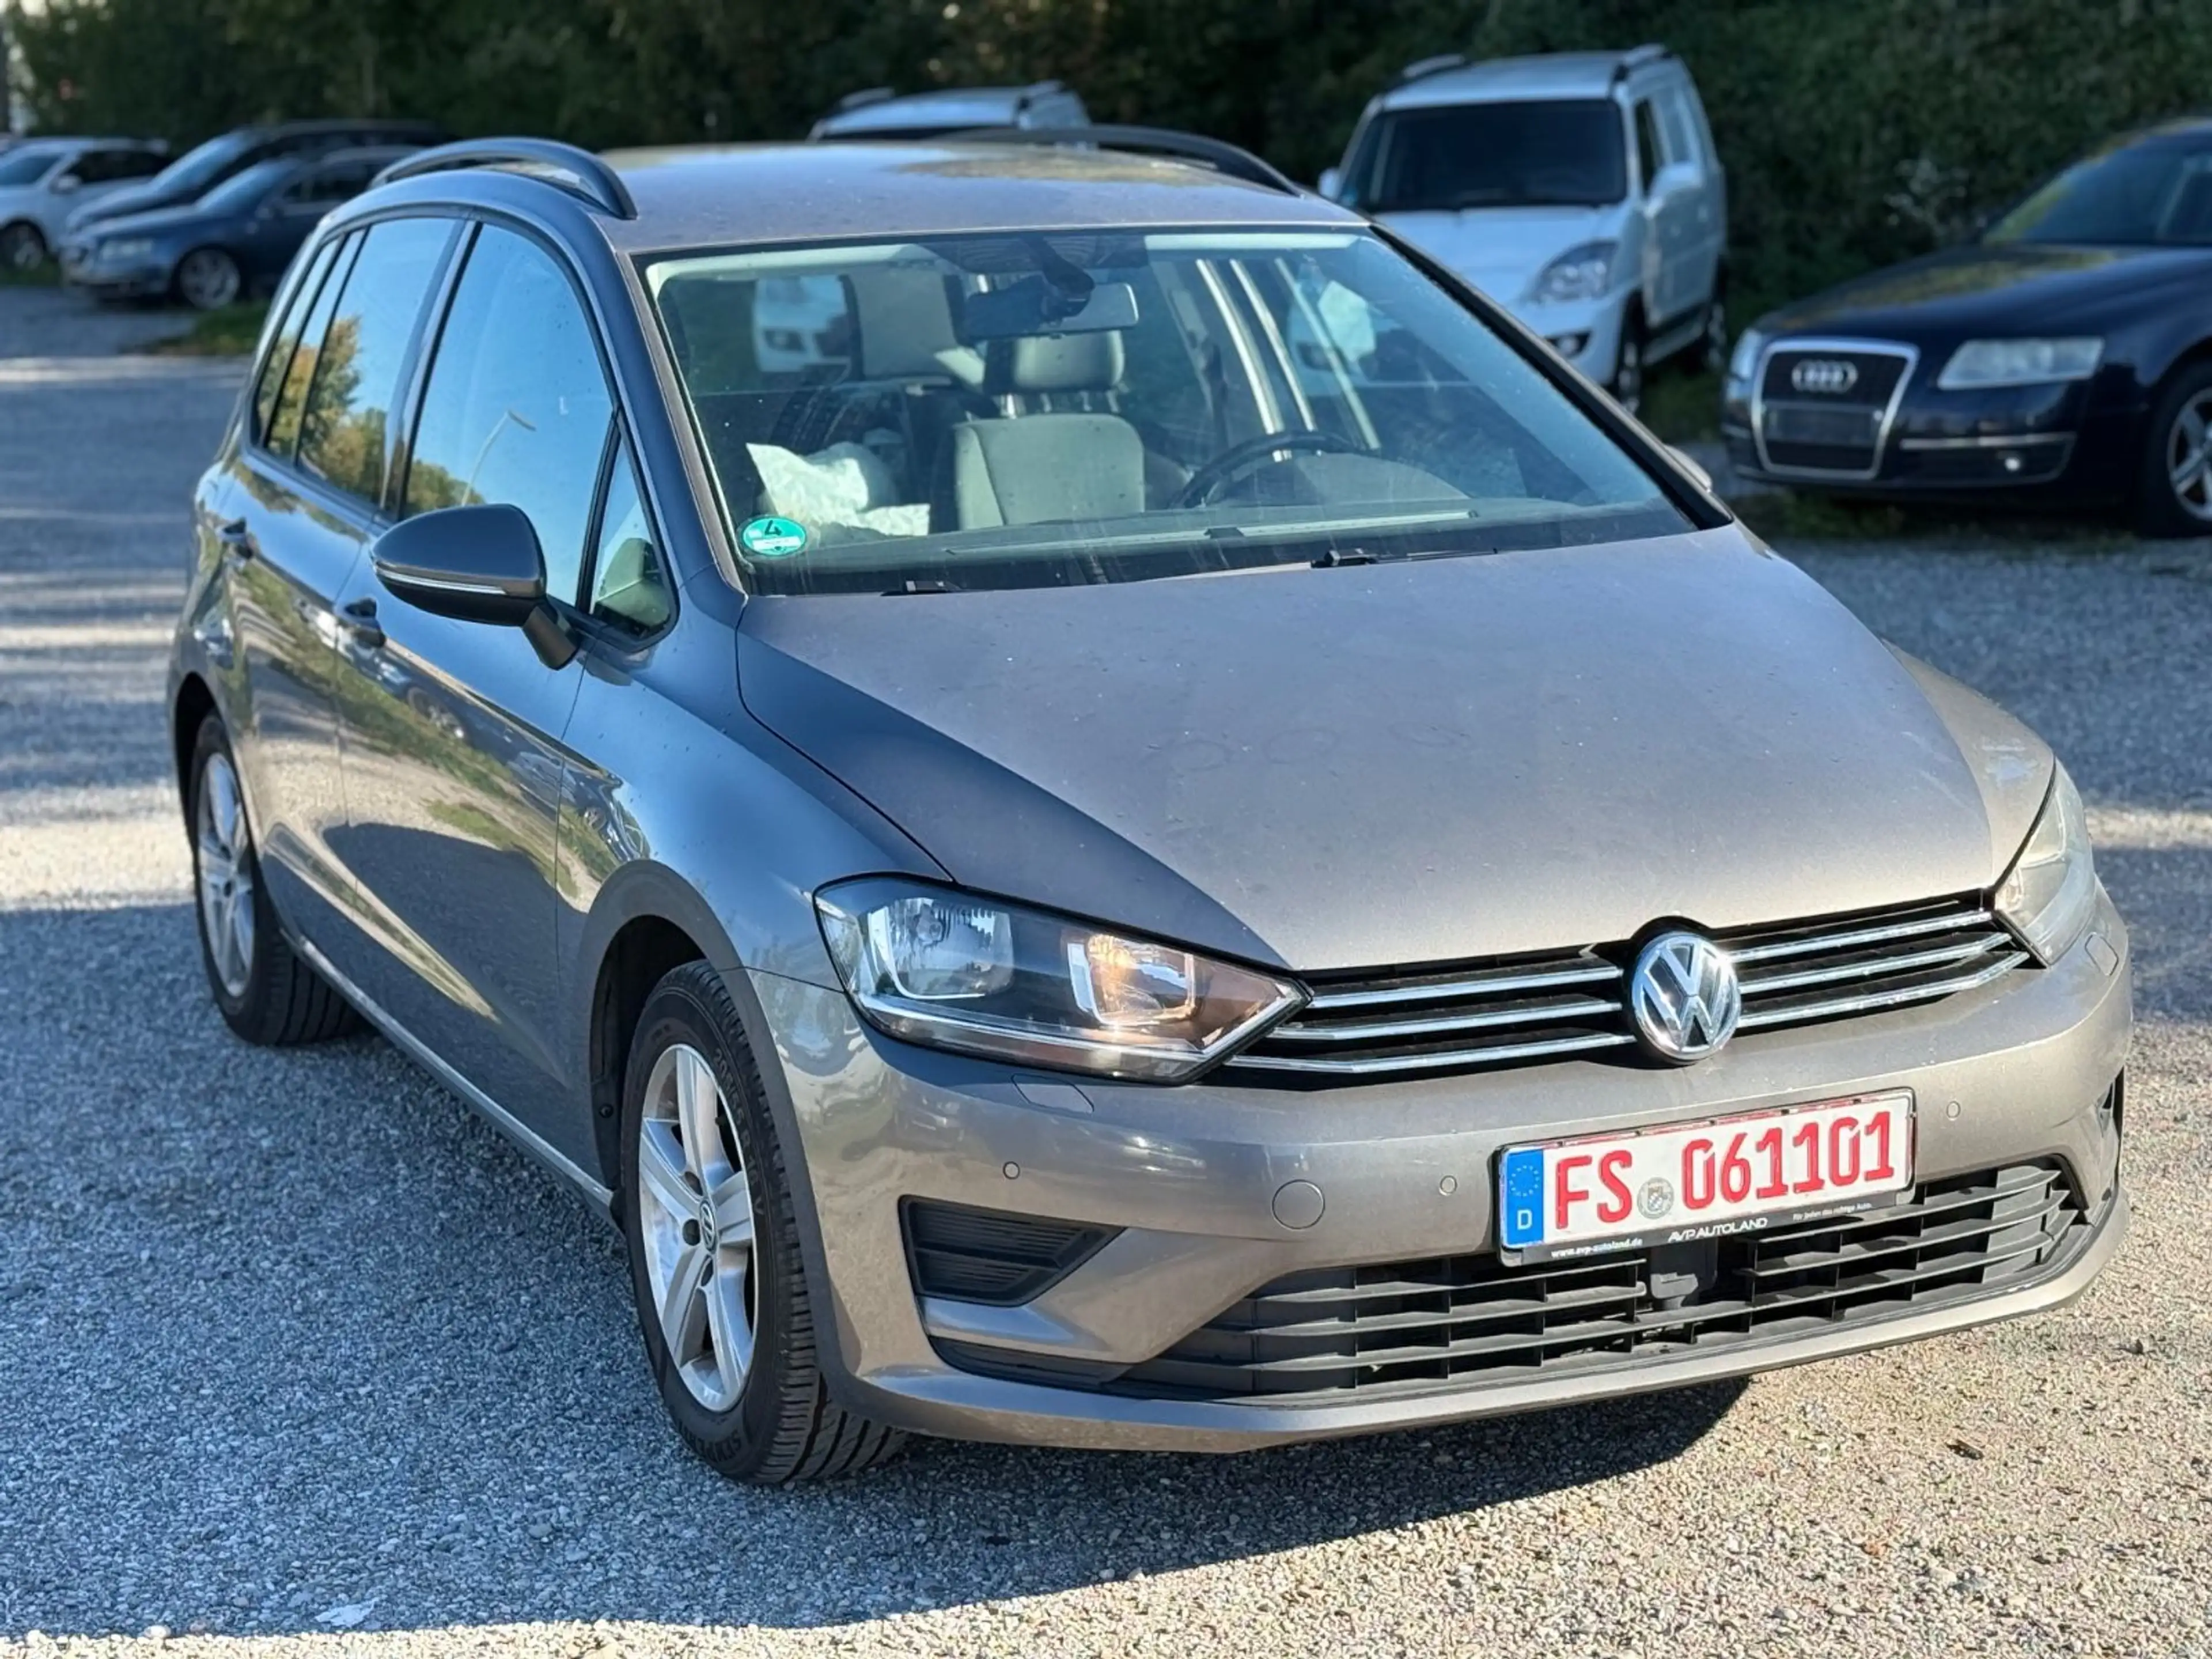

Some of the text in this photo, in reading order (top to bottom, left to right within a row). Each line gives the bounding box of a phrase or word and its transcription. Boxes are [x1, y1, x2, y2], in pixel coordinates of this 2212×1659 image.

[764, 520, 782, 536] 4
[1556, 1111, 1895, 1229] FS 061101
[1517, 1209, 1533, 1230] D
